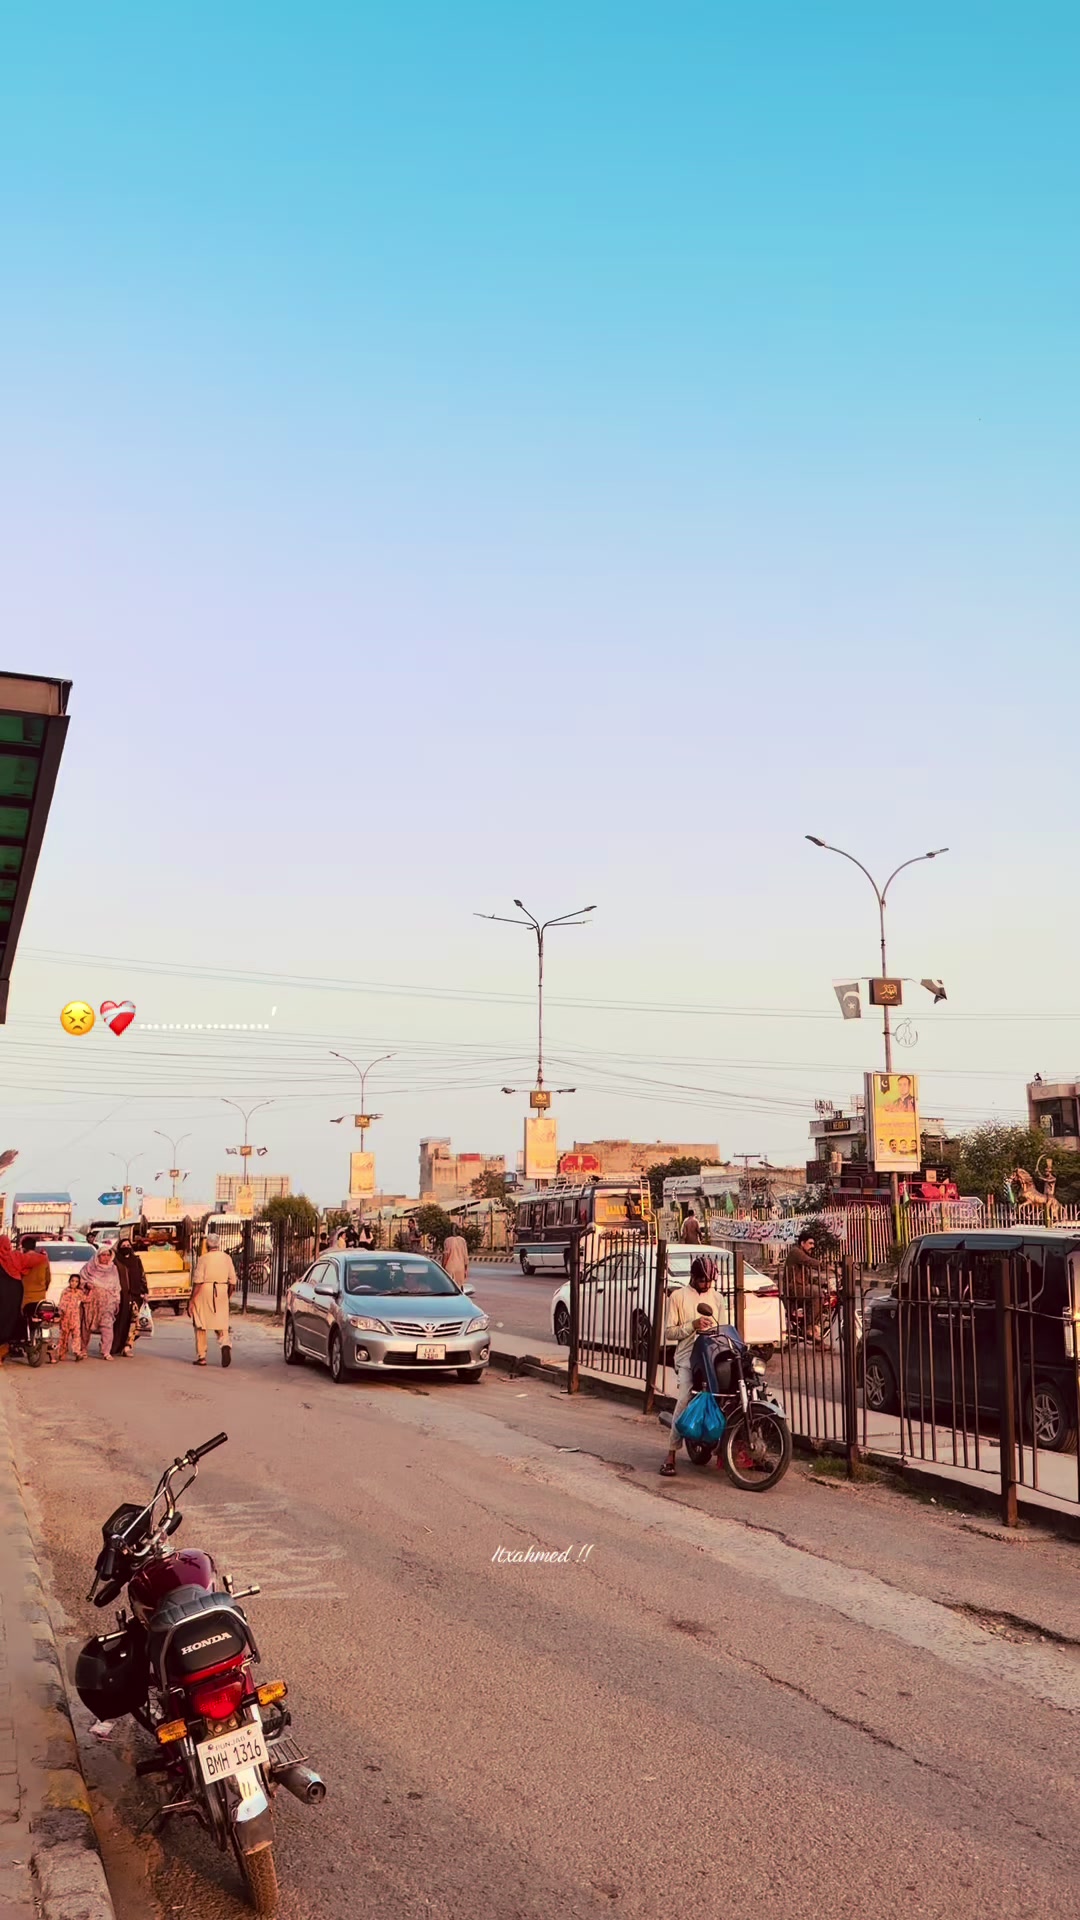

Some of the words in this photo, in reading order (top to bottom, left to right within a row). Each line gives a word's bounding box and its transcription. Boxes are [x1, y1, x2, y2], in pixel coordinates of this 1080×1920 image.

[181, 1632, 232, 1655] HONDA
[205, 1750, 230, 1776] BMH
[233, 1738, 262, 1765] 1316
